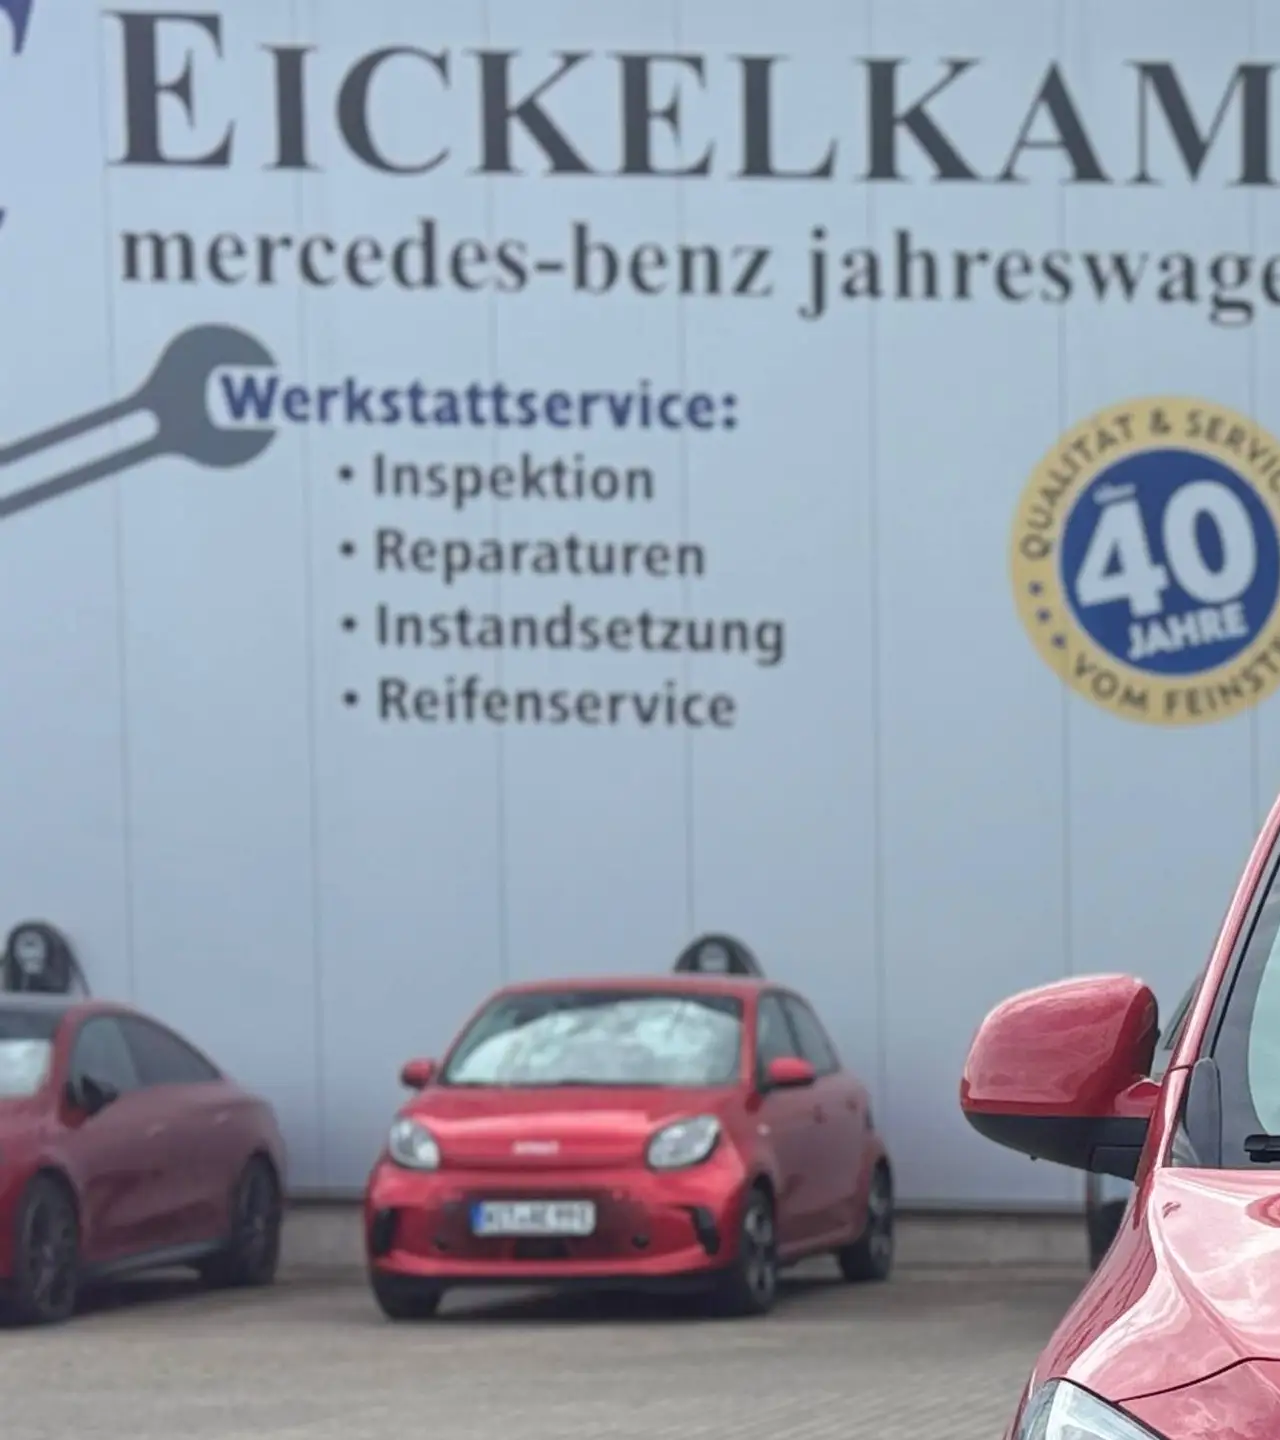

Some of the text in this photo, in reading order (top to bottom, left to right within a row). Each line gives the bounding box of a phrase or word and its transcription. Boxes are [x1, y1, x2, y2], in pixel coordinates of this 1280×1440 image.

[120, 218, 775, 295] mercedes-benz
[219, 374, 740, 431] Werkstattservice:
[1149, 408, 1172, 435] &
[372, 453, 656, 510] Inspektion
[374, 528, 706, 584] Reparaturen
[1075, 479, 1258, 618] 40
[376, 604, 786, 667] Instandsetzung
[1127, 600, 1250, 660] JAHRE
[378, 676, 737, 728] Reifenservice
[1073, 652, 1149, 712] VOM
